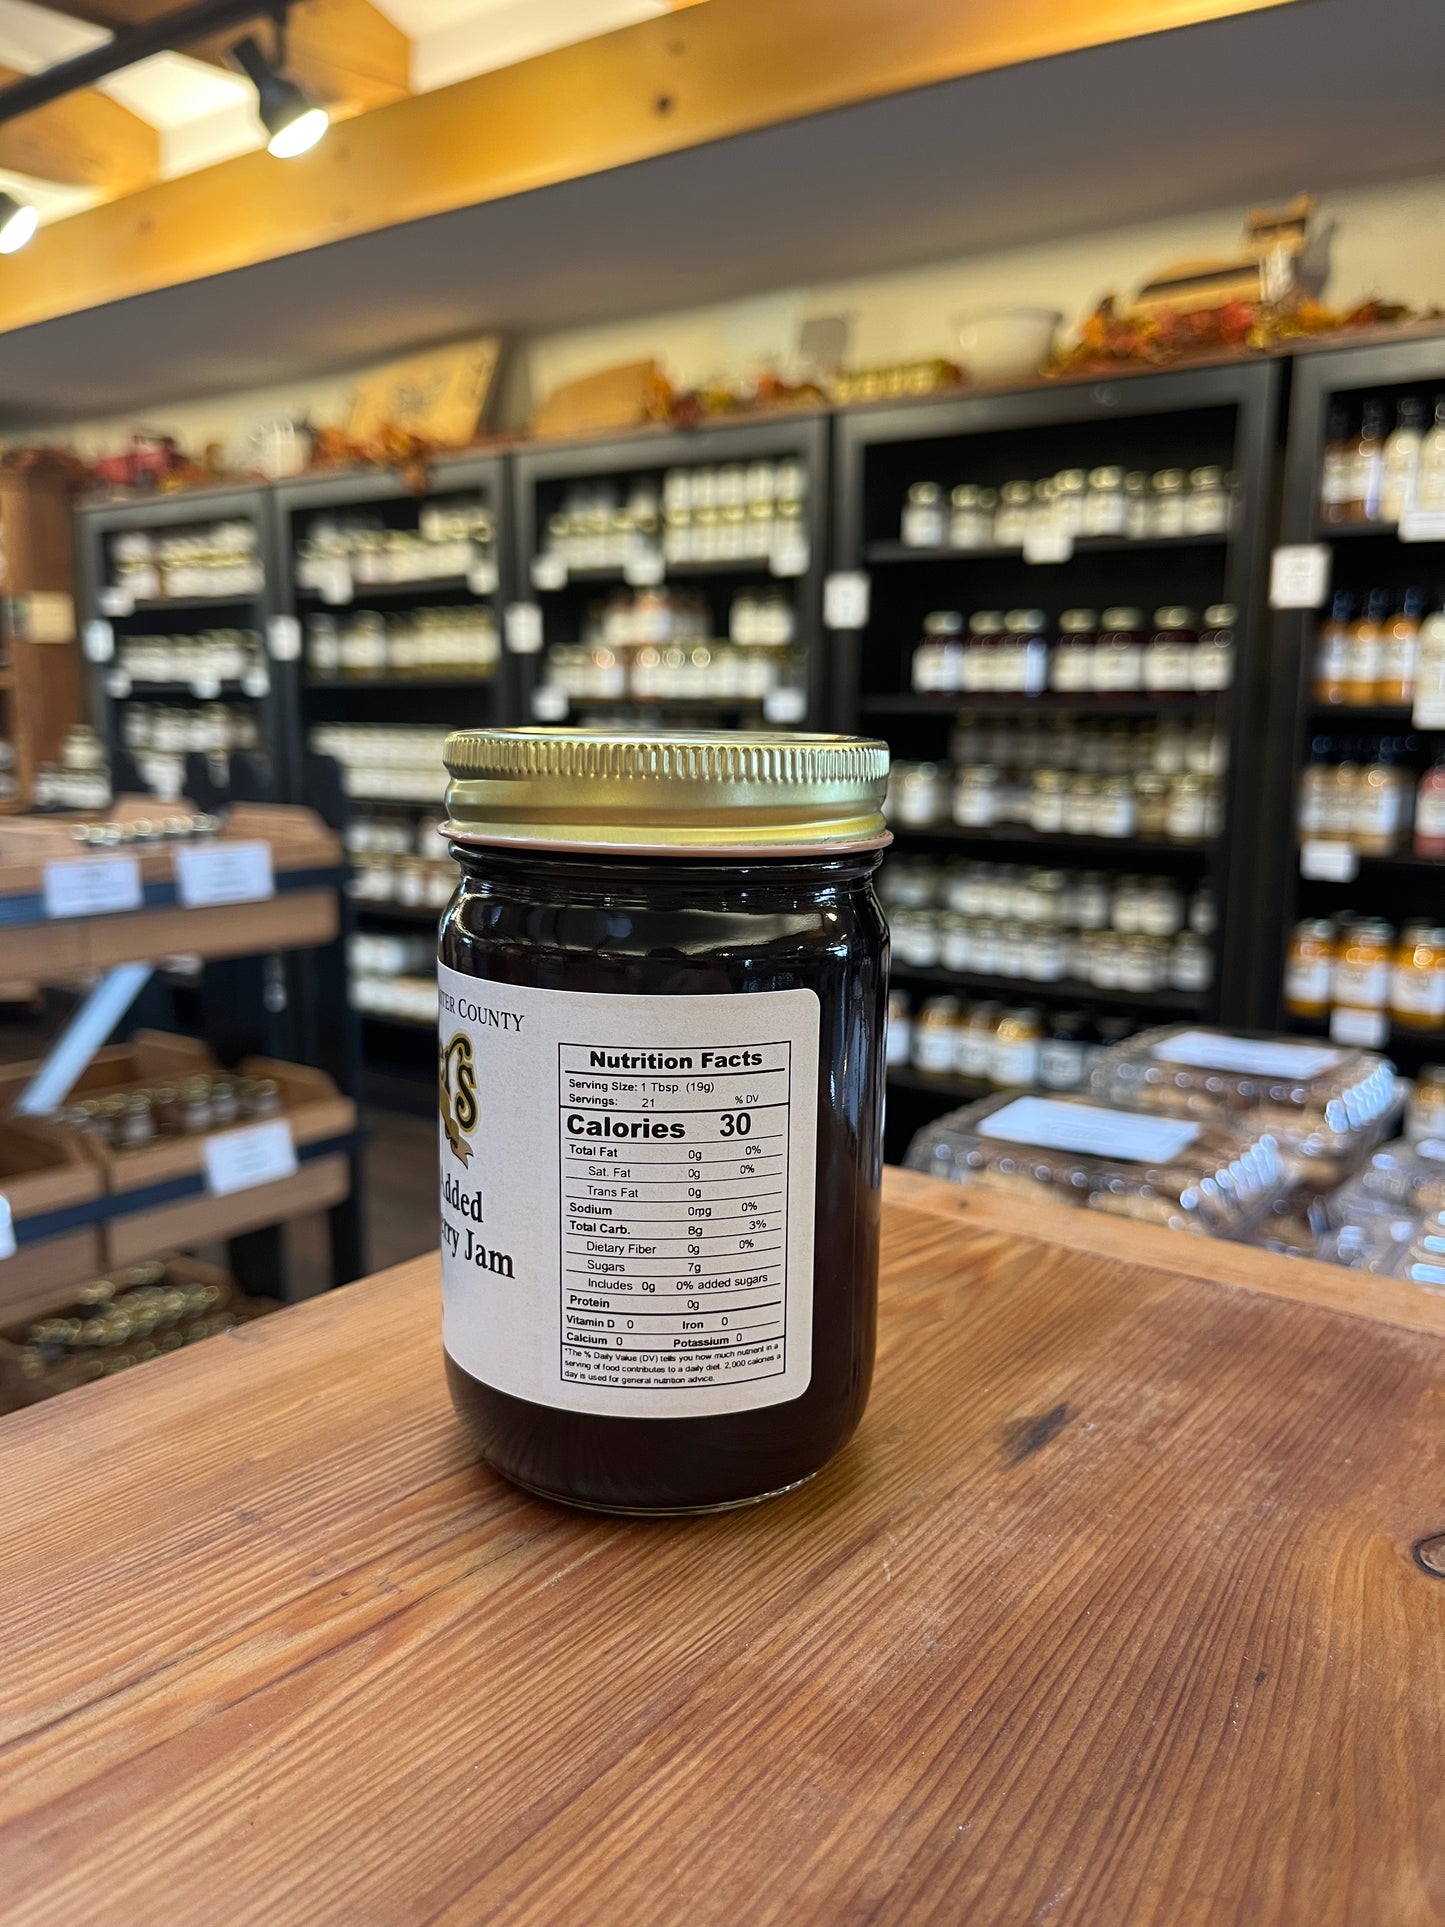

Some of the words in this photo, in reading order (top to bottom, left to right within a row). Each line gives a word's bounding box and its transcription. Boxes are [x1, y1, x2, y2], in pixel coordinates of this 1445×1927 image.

[459, 999, 524, 1031] COUNTY
[590, 1051, 692, 1069] Nutrition
[702, 1051, 762, 1068] Facts
[569, 1079, 608, 1092] Serving
[612, 1082, 637, 1091] Size:
[642, 1083, 646, 1092] 1
[651, 1083, 681, 1093] Tbsp.
[686, 1082, 714, 1093] (19g)
[569, 1094, 618, 1106] Servings:
[642, 1099, 655, 1107] 21
[735, 1096, 743, 1104] %
[746, 1095, 759, 1103] DV
[567, 1114, 685, 1138] Calories
[720, 1113, 751, 1136] 30
[570, 1144, 596, 1155] Total
[600, 1148, 618, 1157] Fat
[688, 1150, 702, 1160] 0g
[745, 1146, 761, 1155] 0%
[589, 1166, 609, 1176] Sat.
[614, 1168, 630, 1177] Fat
[688, 1169, 700, 1179] 0g
[740, 1165, 754, 1174] 0%
[587, 1185, 617, 1197] Trans
[621, 1188, 638, 1197] Fat
[688, 1188, 701, 1198] 0g
[570, 1203, 612, 1215] Sodium
[688, 1207, 711, 1217] 0mg
[741, 1202, 757, 1211] 0%
[570, 1221, 596, 1232] Total
[600, 1223, 630, 1234] Carb.
[688, 1226, 702, 1236] 8g
[749, 1220, 766, 1229] 3%
[465, 1229, 515, 1279] Jam
[587, 1241, 624, 1254] Dietary
[629, 1244, 656, 1254] Fiber
[688, 1245, 699, 1255] 0g
[739, 1239, 754, 1248] 0%
[587, 1261, 625, 1272] Sugars
[688, 1263, 701, 1273] 7g
[588, 1279, 632, 1290] Includes
[642, 1281, 655, 1292] 0g
[676, 1281, 693, 1290] 0%
[698, 1279, 731, 1289] added
[735, 1274, 767, 1286] sugars
[570, 1296, 610, 1308] Protein
[688, 1300, 699, 1310] 0g
[567, 1316, 604, 1328] Vitamin
[608, 1319, 615, 1328] D
[627, 1320, 634, 1329] 0
[683, 1320, 703, 1329] Iron
[721, 1317, 728, 1326] 0
[567, 1333, 607, 1345] Calcium
[616, 1337, 622, 1345] 0
[673, 1337, 729, 1348] Potassium
[736, 1333, 742, 1342] 0
[594, 1352, 613, 1361] Daily
[737, 1346, 764, 1356] nutrient
[565, 1361, 591, 1370] serving
[685, 1365, 703, 1373] daily
[748, 1356, 774, 1365] calories
